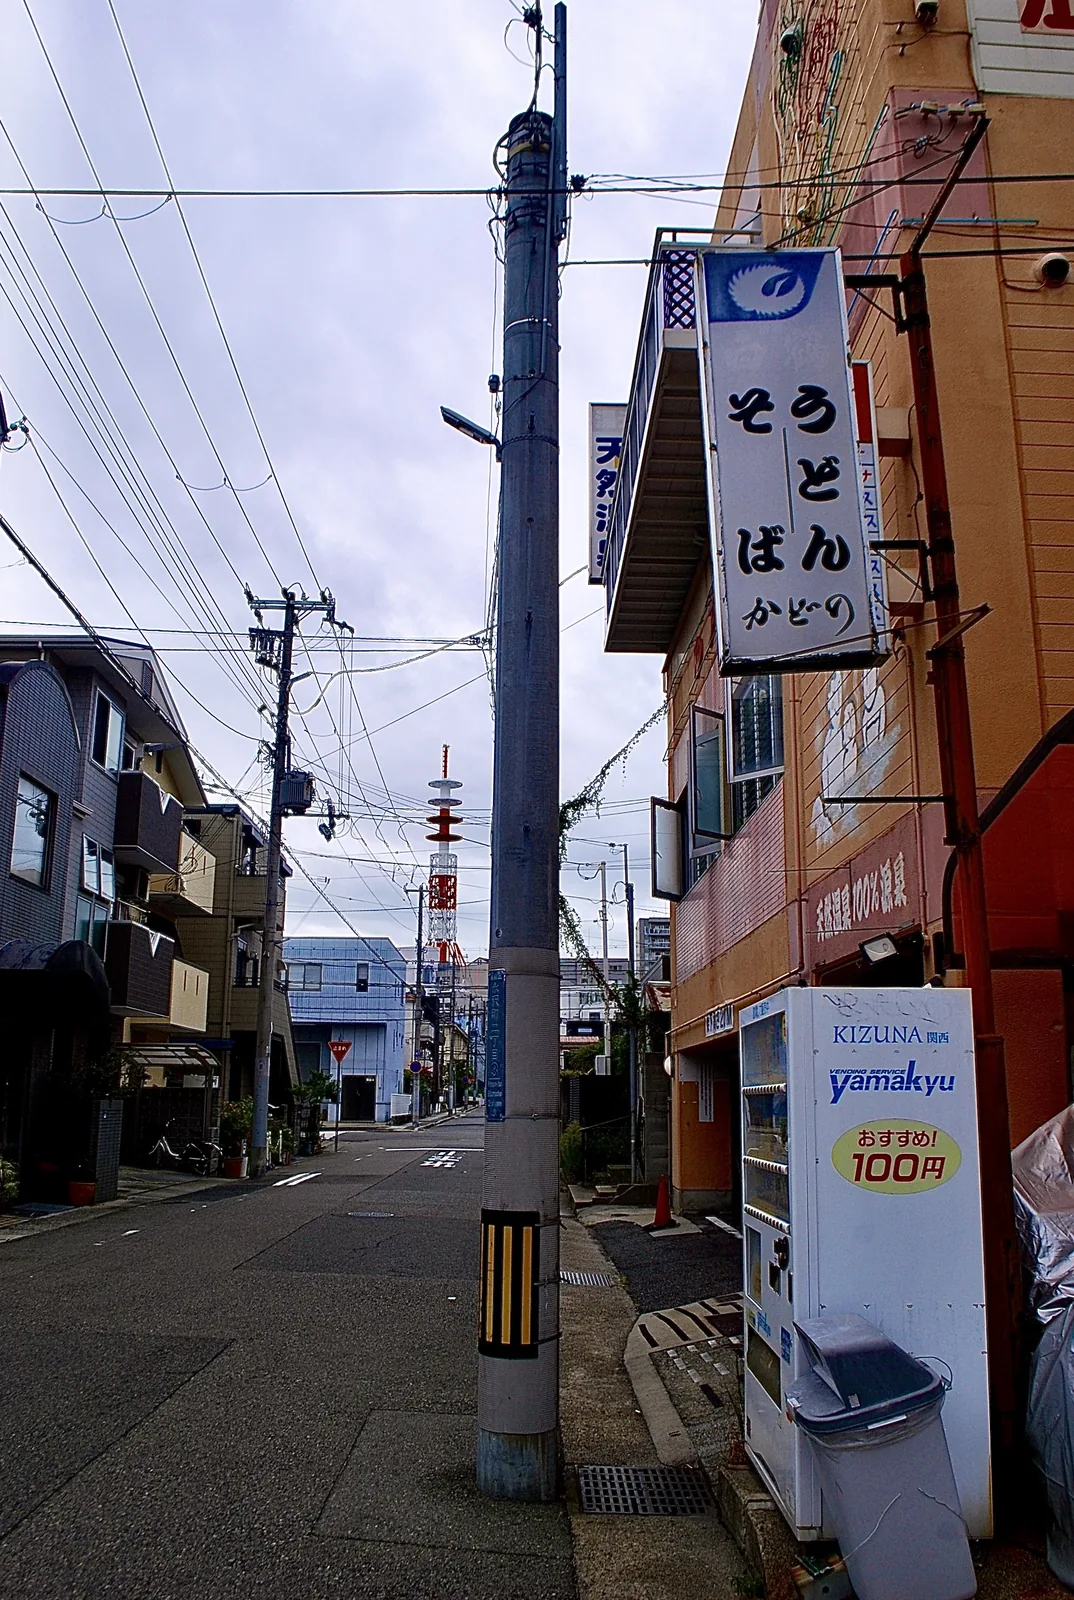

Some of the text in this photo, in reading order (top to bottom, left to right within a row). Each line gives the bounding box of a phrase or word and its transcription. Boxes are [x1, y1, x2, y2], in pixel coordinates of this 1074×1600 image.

[727, 387, 785, 575] そば
[790, 383, 851, 572] うどん
[742, 592, 855, 637] かどの
[832, 1025, 949, 1044] KIZUNA 関西
[829, 1060, 955, 1105] yamakyu
[858, 1129, 938, 1148] おすすめ!
[852, 1152, 946, 1183] 100円
